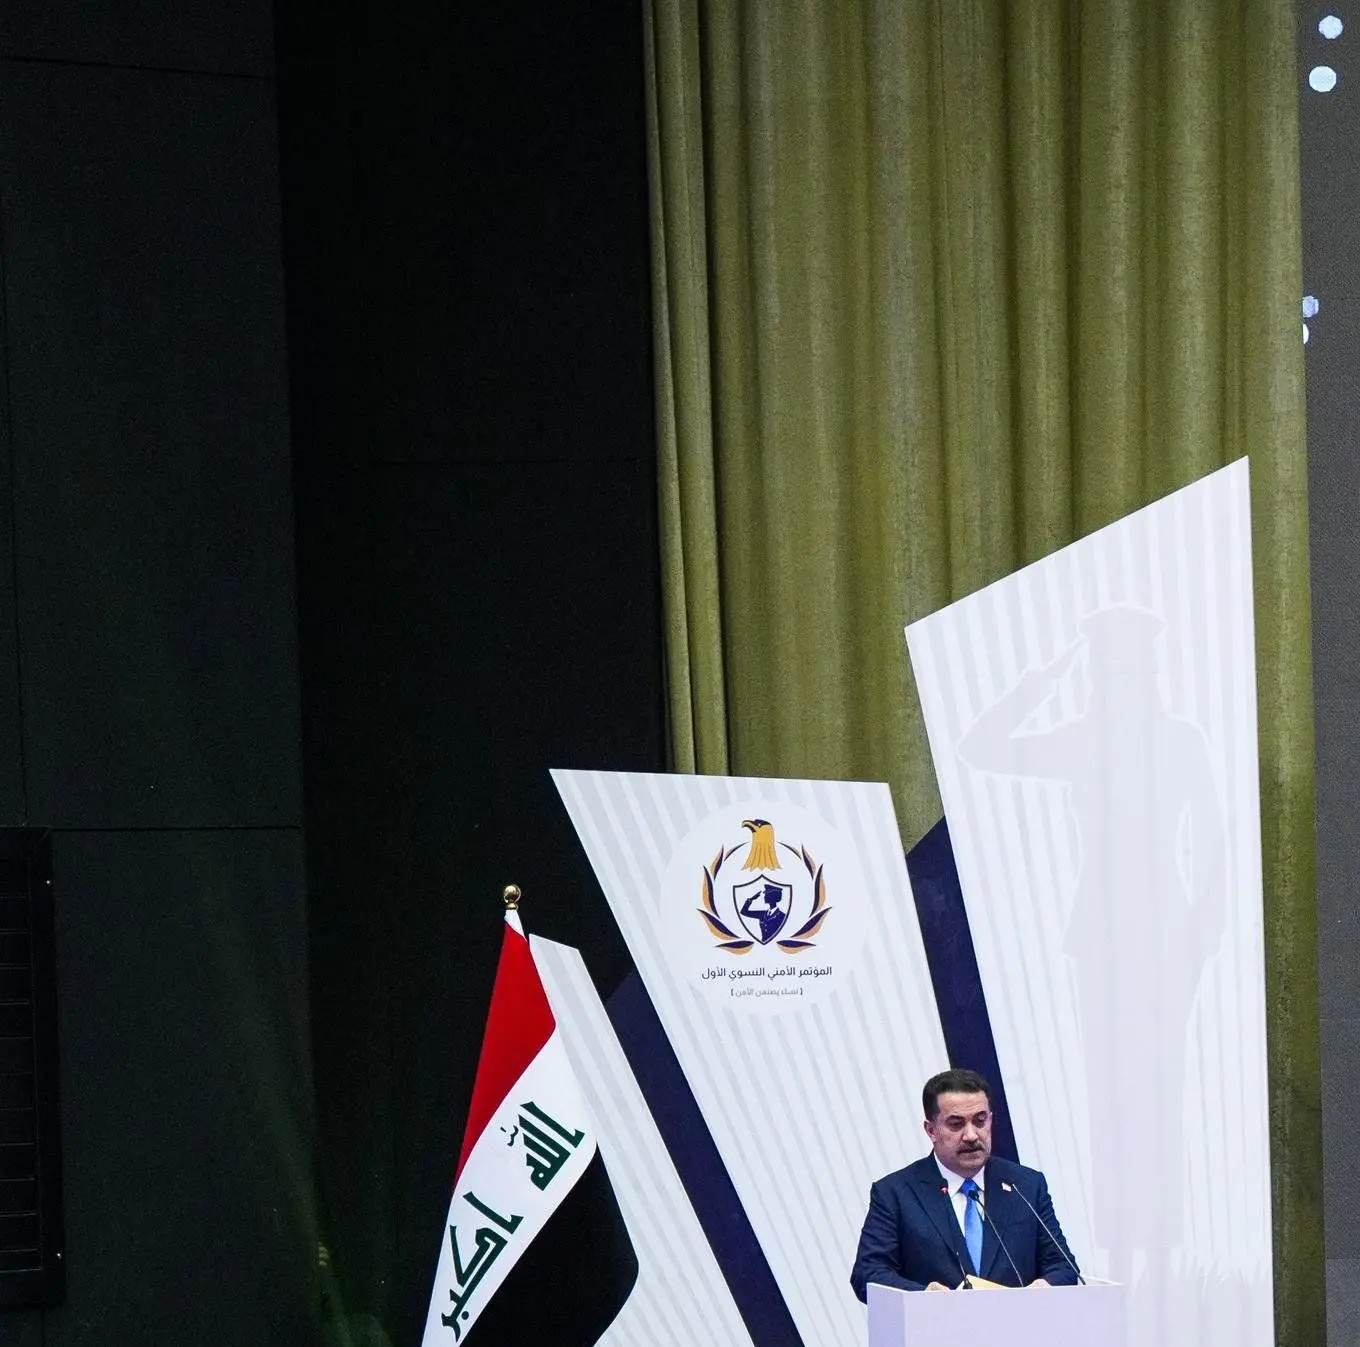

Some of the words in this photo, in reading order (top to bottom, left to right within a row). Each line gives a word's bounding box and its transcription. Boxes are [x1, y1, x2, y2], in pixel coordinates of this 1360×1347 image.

[701, 966, 726, 980] الأول
[728, 966, 765, 981] النسوي
[767, 965, 796, 980] الأمني
[799, 966, 832, 978] المؤتمر
